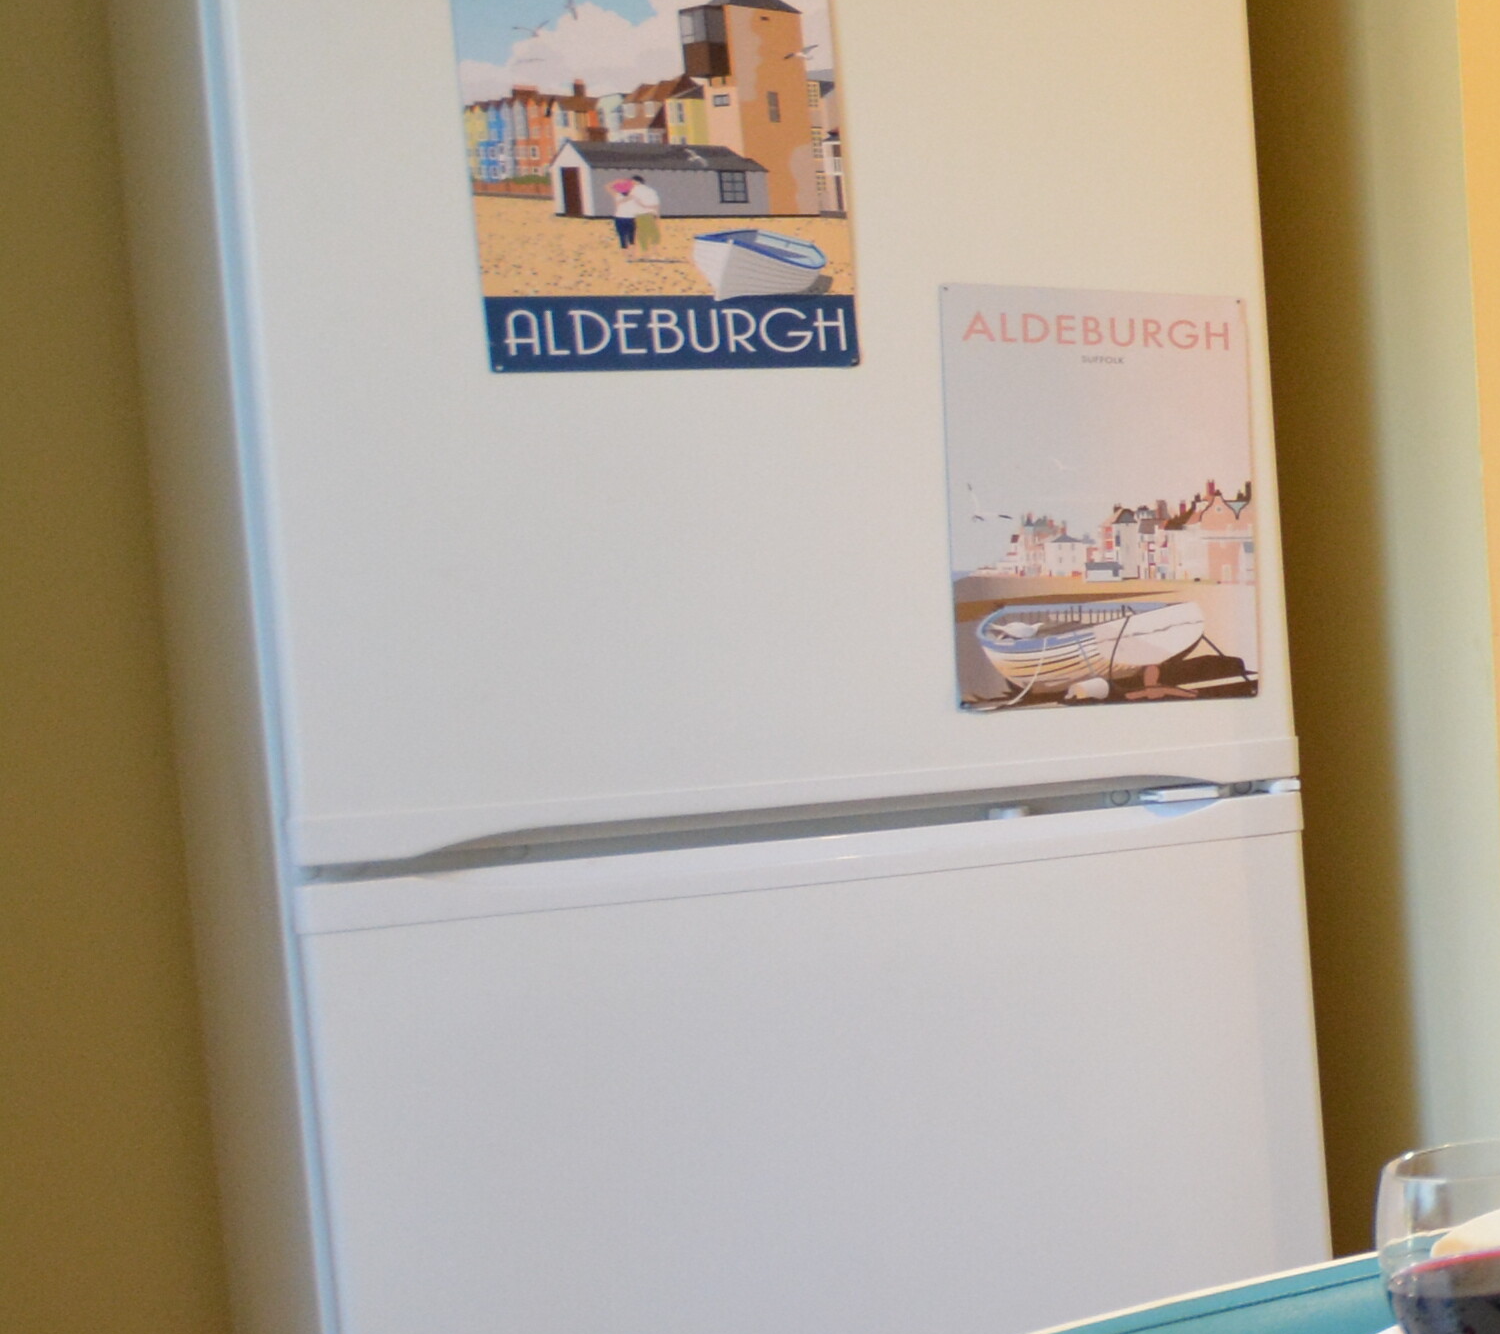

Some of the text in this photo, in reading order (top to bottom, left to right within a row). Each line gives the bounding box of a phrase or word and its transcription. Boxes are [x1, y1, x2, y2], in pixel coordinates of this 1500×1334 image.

[504, 307, 848, 356] ALDEBURGH
[961, 310, 1231, 352] ALDEBURGH
[1080, 354, 1126, 365] SUFFOLK
